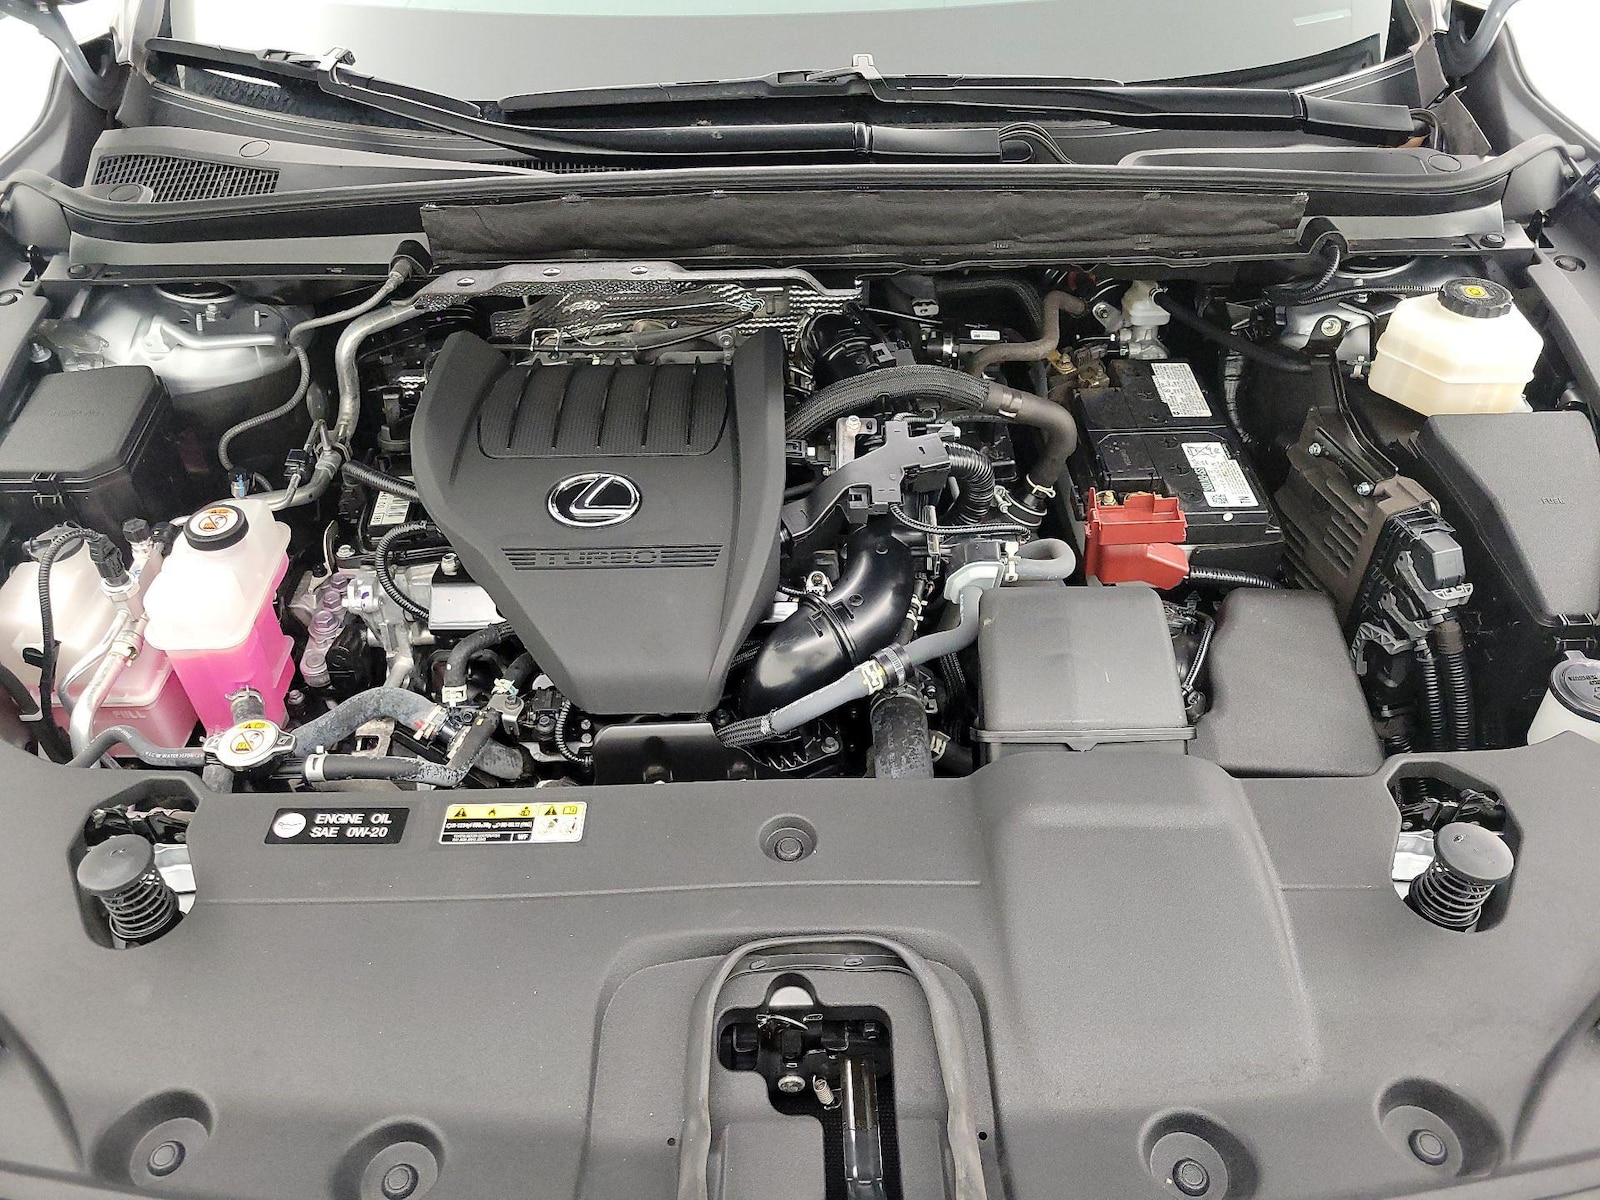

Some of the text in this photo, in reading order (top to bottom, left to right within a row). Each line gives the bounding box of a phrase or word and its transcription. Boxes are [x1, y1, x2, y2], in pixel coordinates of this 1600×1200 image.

[540, 550, 657, 565] TURBO
[315, 812, 392, 824] ENGINE OIL
[310, 826, 389, 838] SAE 0W-20
